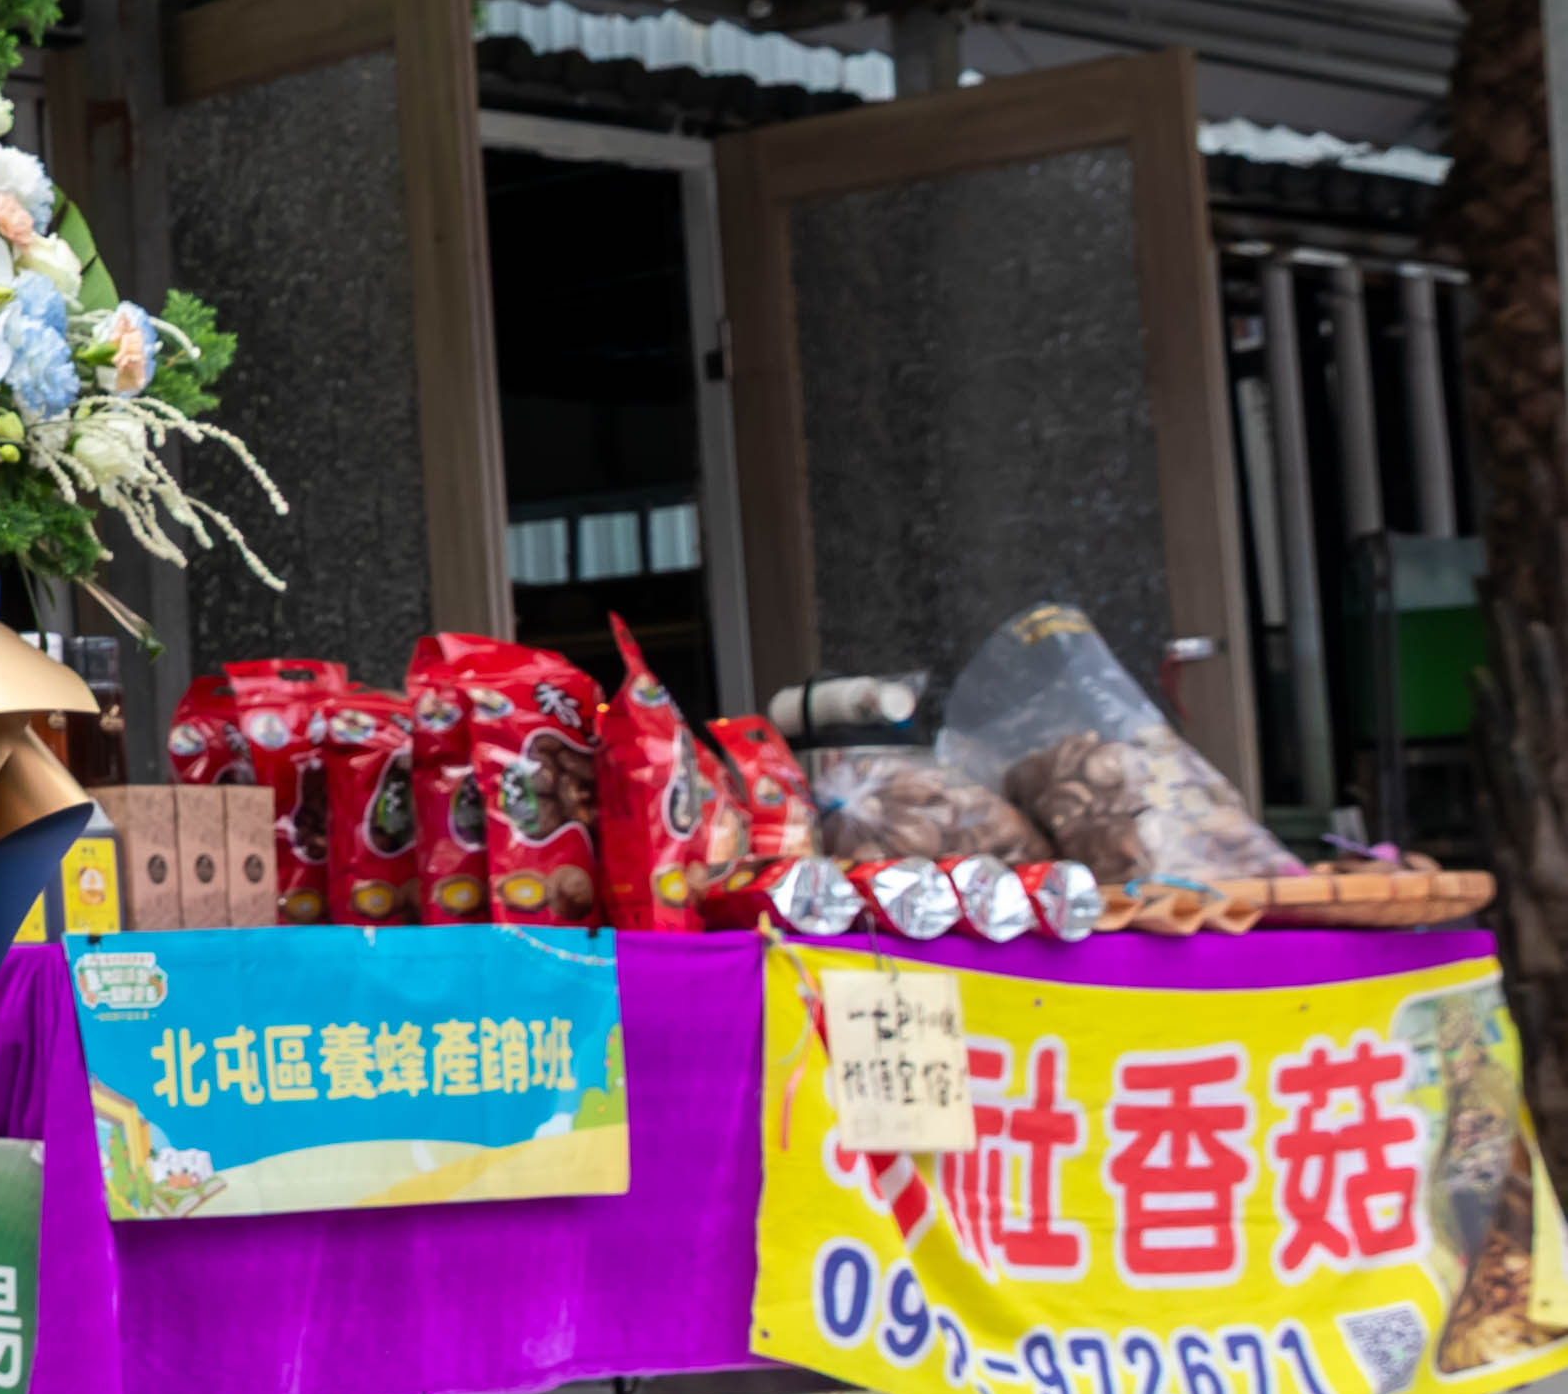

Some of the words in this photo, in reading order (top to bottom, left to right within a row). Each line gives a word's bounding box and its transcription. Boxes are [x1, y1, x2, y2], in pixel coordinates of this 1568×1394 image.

[150, 1017, 575, 1107] 北屯區養蜂產銷班
